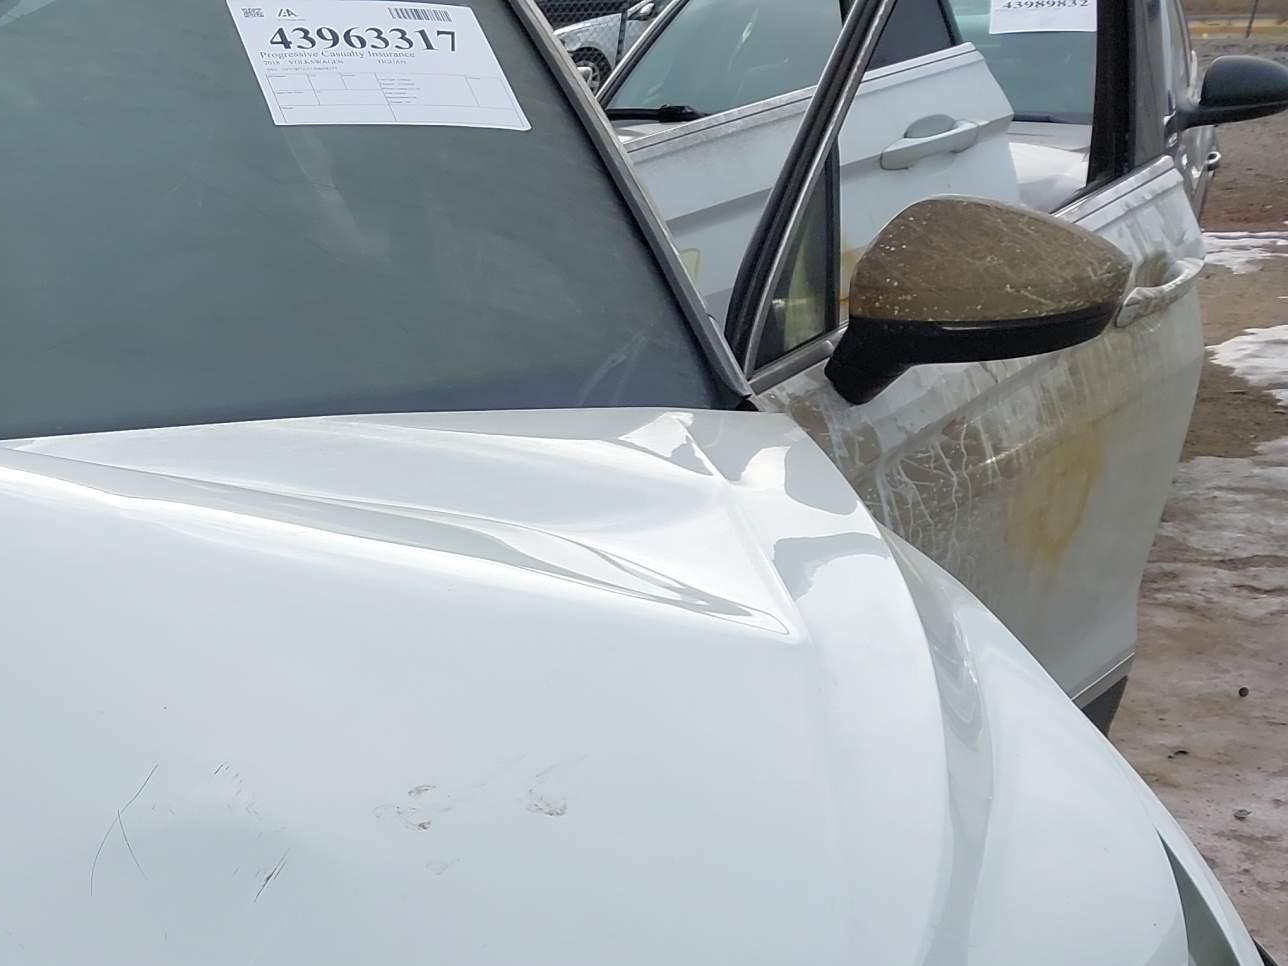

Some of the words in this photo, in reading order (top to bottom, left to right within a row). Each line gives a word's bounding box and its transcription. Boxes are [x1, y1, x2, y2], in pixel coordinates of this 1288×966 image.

[269, 26, 456, 52] 43963317
[259, 51, 318, 60] Progressive
[320, 50, 365, 59] Casualty
